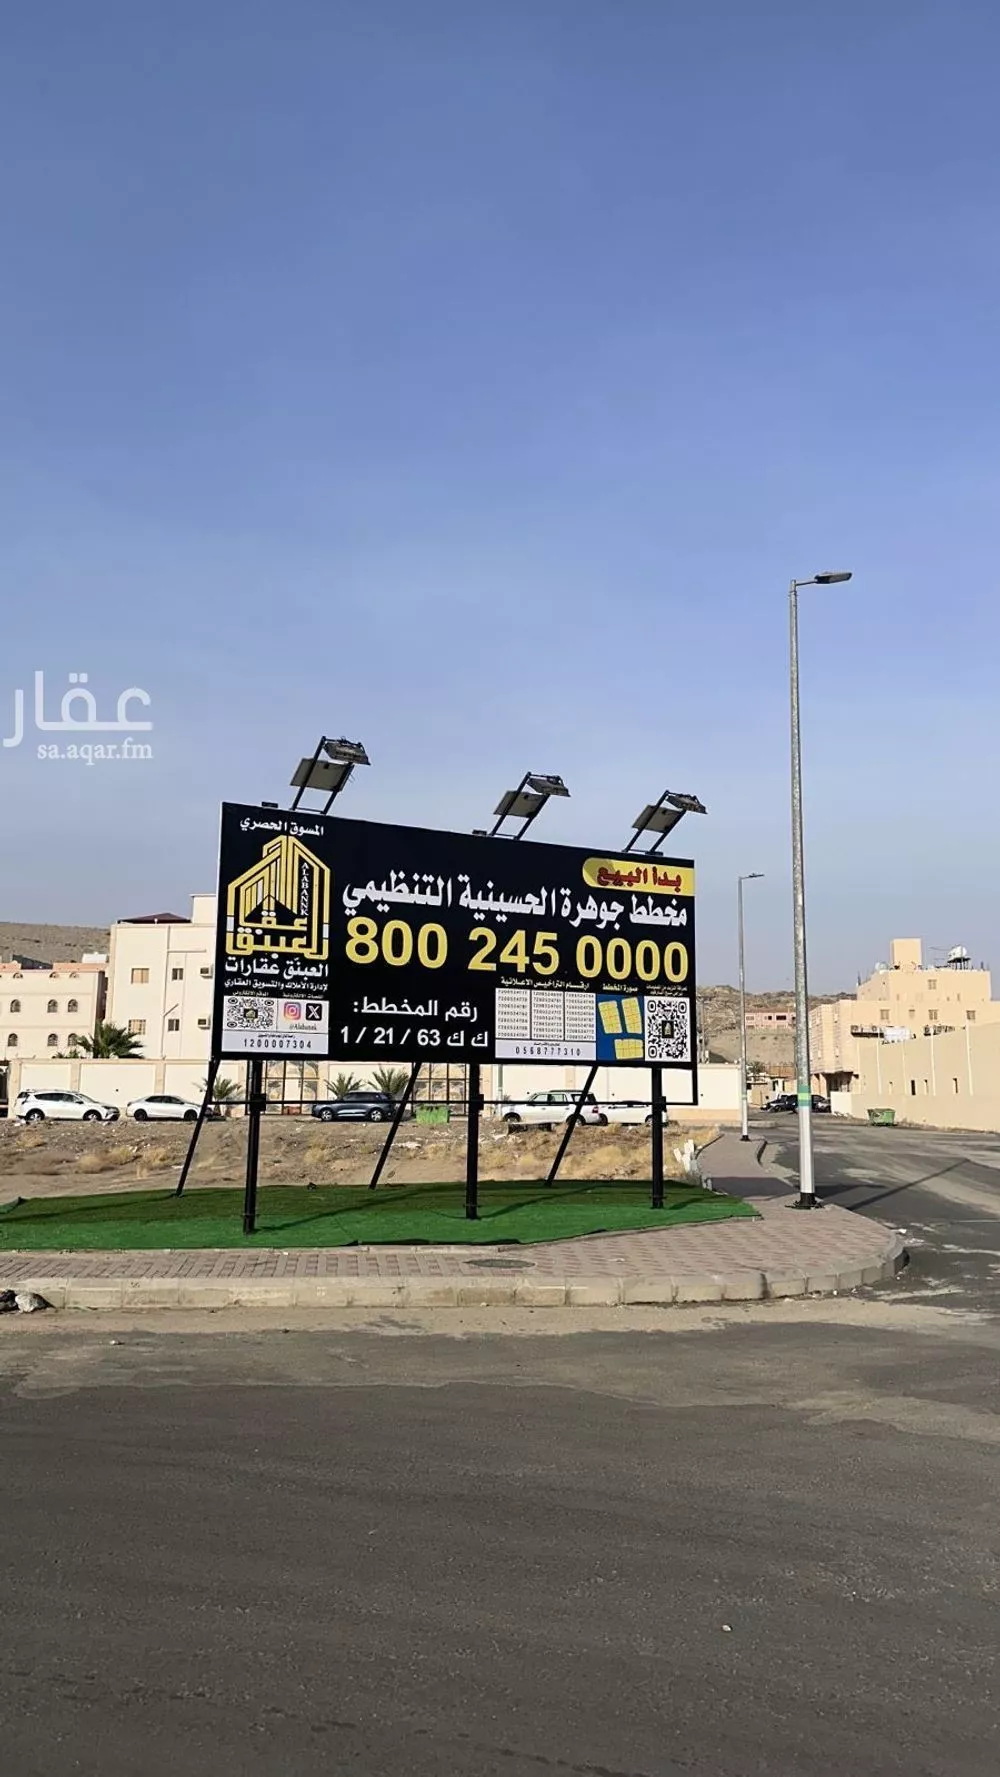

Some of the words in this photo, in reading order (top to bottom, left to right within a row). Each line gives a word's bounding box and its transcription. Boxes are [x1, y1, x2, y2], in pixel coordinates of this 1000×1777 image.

[240, 817, 288, 831] الحصري
[290, 821, 324, 836] المسوق
[597, 867, 648, 887] البيع
[300, 862, 309, 916] ALABANNK
[342, 869, 452, 916] التنظيمي
[458, 873, 556, 922] الحسينية
[560, 887, 625, 930] جوهرة
[629, 894, 688, 927] مخطط
[345, 916, 448, 969] 800
[467, 926, 560, 975] 245
[576, 935, 689, 982] 0000
[225, 956, 280, 976] عقارات
[224, 978, 251, 988] العقاري
[252, 979, 284, 990] والتسويق
[534, 979, 565, 988] التراخيص
[353, 996, 438, 1016] المخطط:
[445, 1001, 478, 1022] رقم
[244, 1038, 312, 1049] 1200007304
[341, 1026, 349, 1043] 1
[373, 1027, 394, 1044] 21
[417, 1028, 441, 1046] 63
